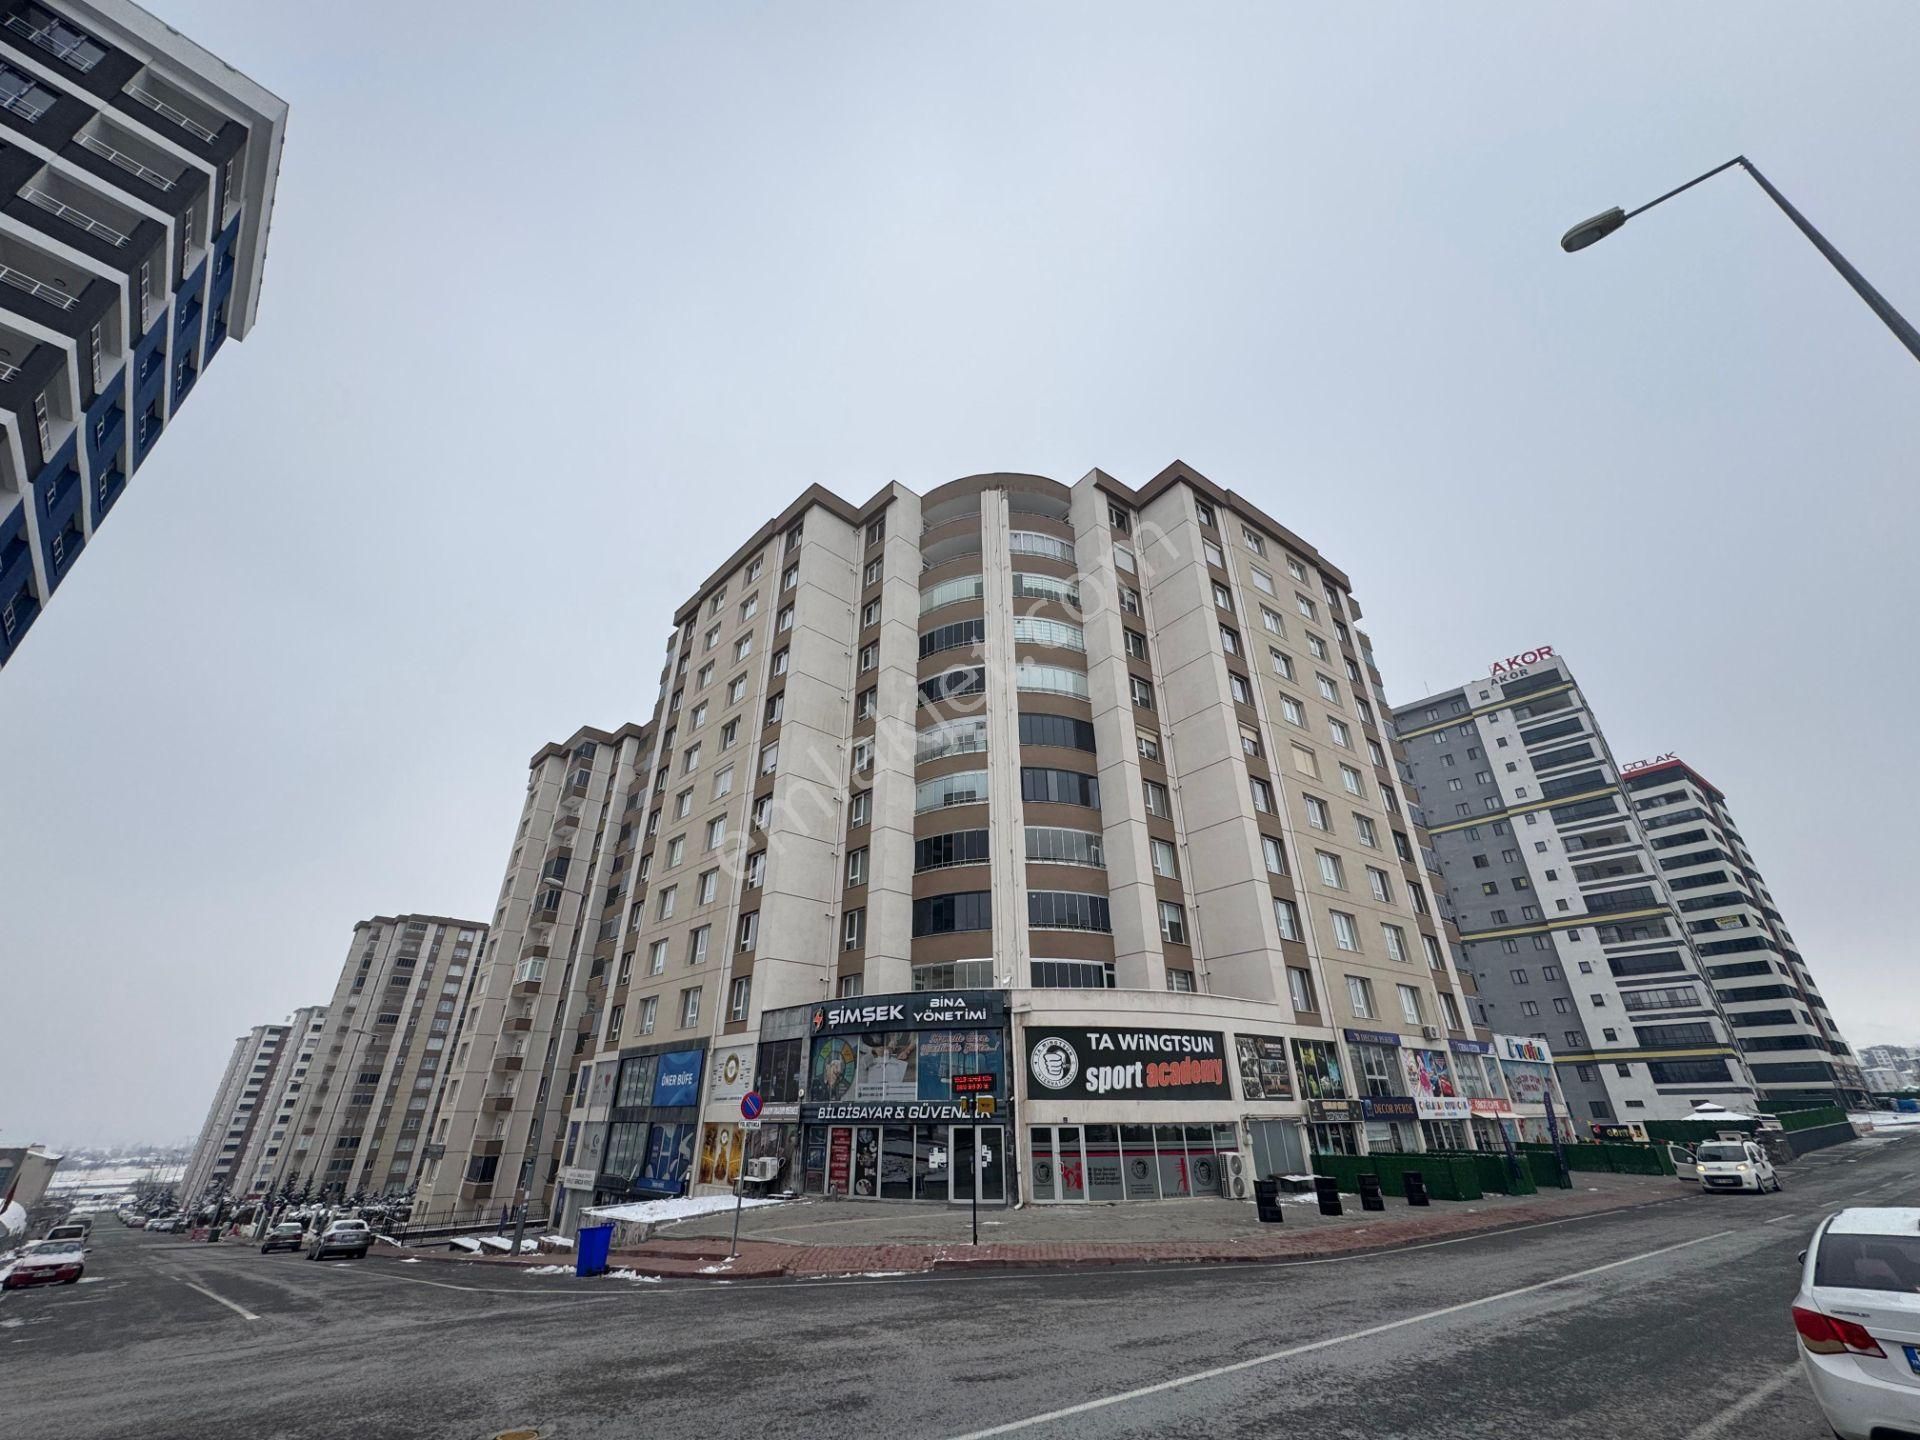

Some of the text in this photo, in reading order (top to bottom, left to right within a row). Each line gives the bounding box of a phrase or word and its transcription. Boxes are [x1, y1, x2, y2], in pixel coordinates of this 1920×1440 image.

[1492, 645, 1555, 676] AKOR
[1491, 668, 1529, 686] AKOR
[930, 996, 966, 1008] BİNA
[828, 1004, 905, 1030] ŞİMŞEK
[913, 1008, 987, 1022] YÖNETİMİ
[1086, 1033, 1112, 1051] TA
[1085, 1056, 1223, 1094] sport academy
[818, 1104, 893, 1119] BİLGİSAYAR
[894, 1107, 905, 1119] &
